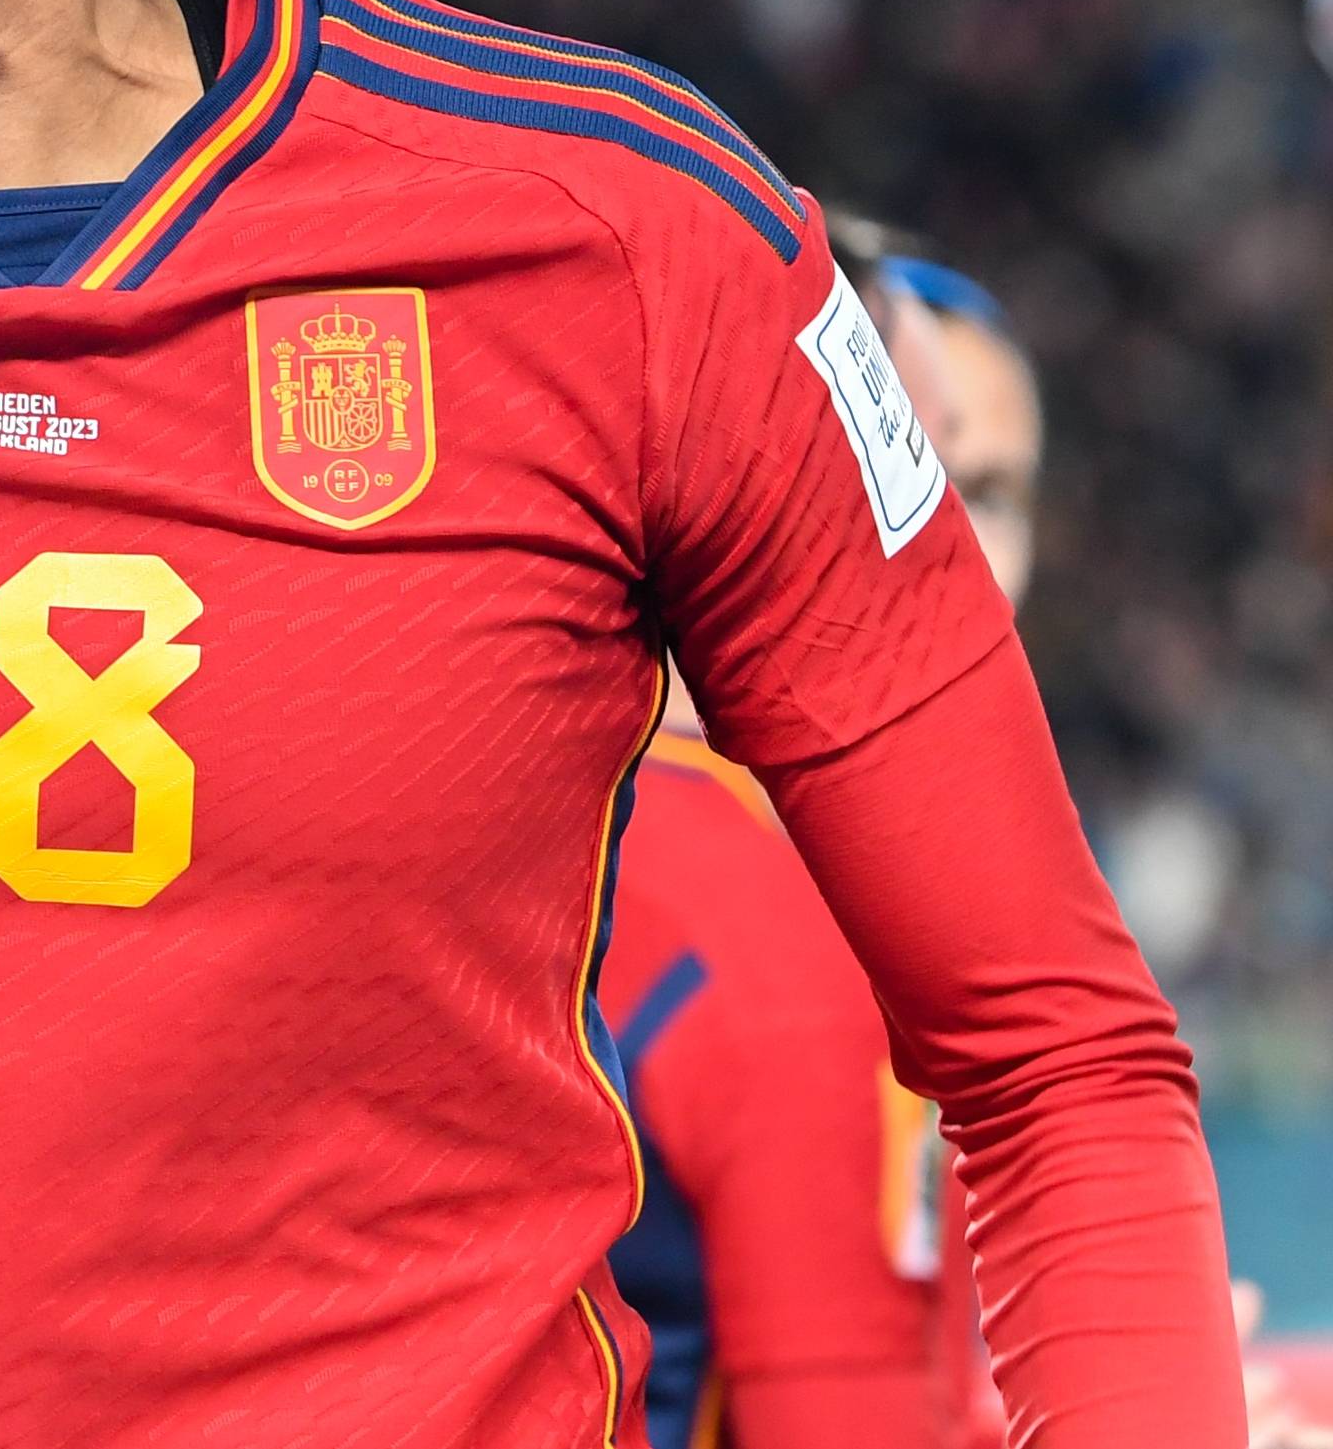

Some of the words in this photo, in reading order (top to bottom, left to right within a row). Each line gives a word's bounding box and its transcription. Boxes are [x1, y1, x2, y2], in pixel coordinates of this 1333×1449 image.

[45, 417, 98, 440] 2023
[302, 475, 318, 489] 19
[374, 473, 393, 487] 09
